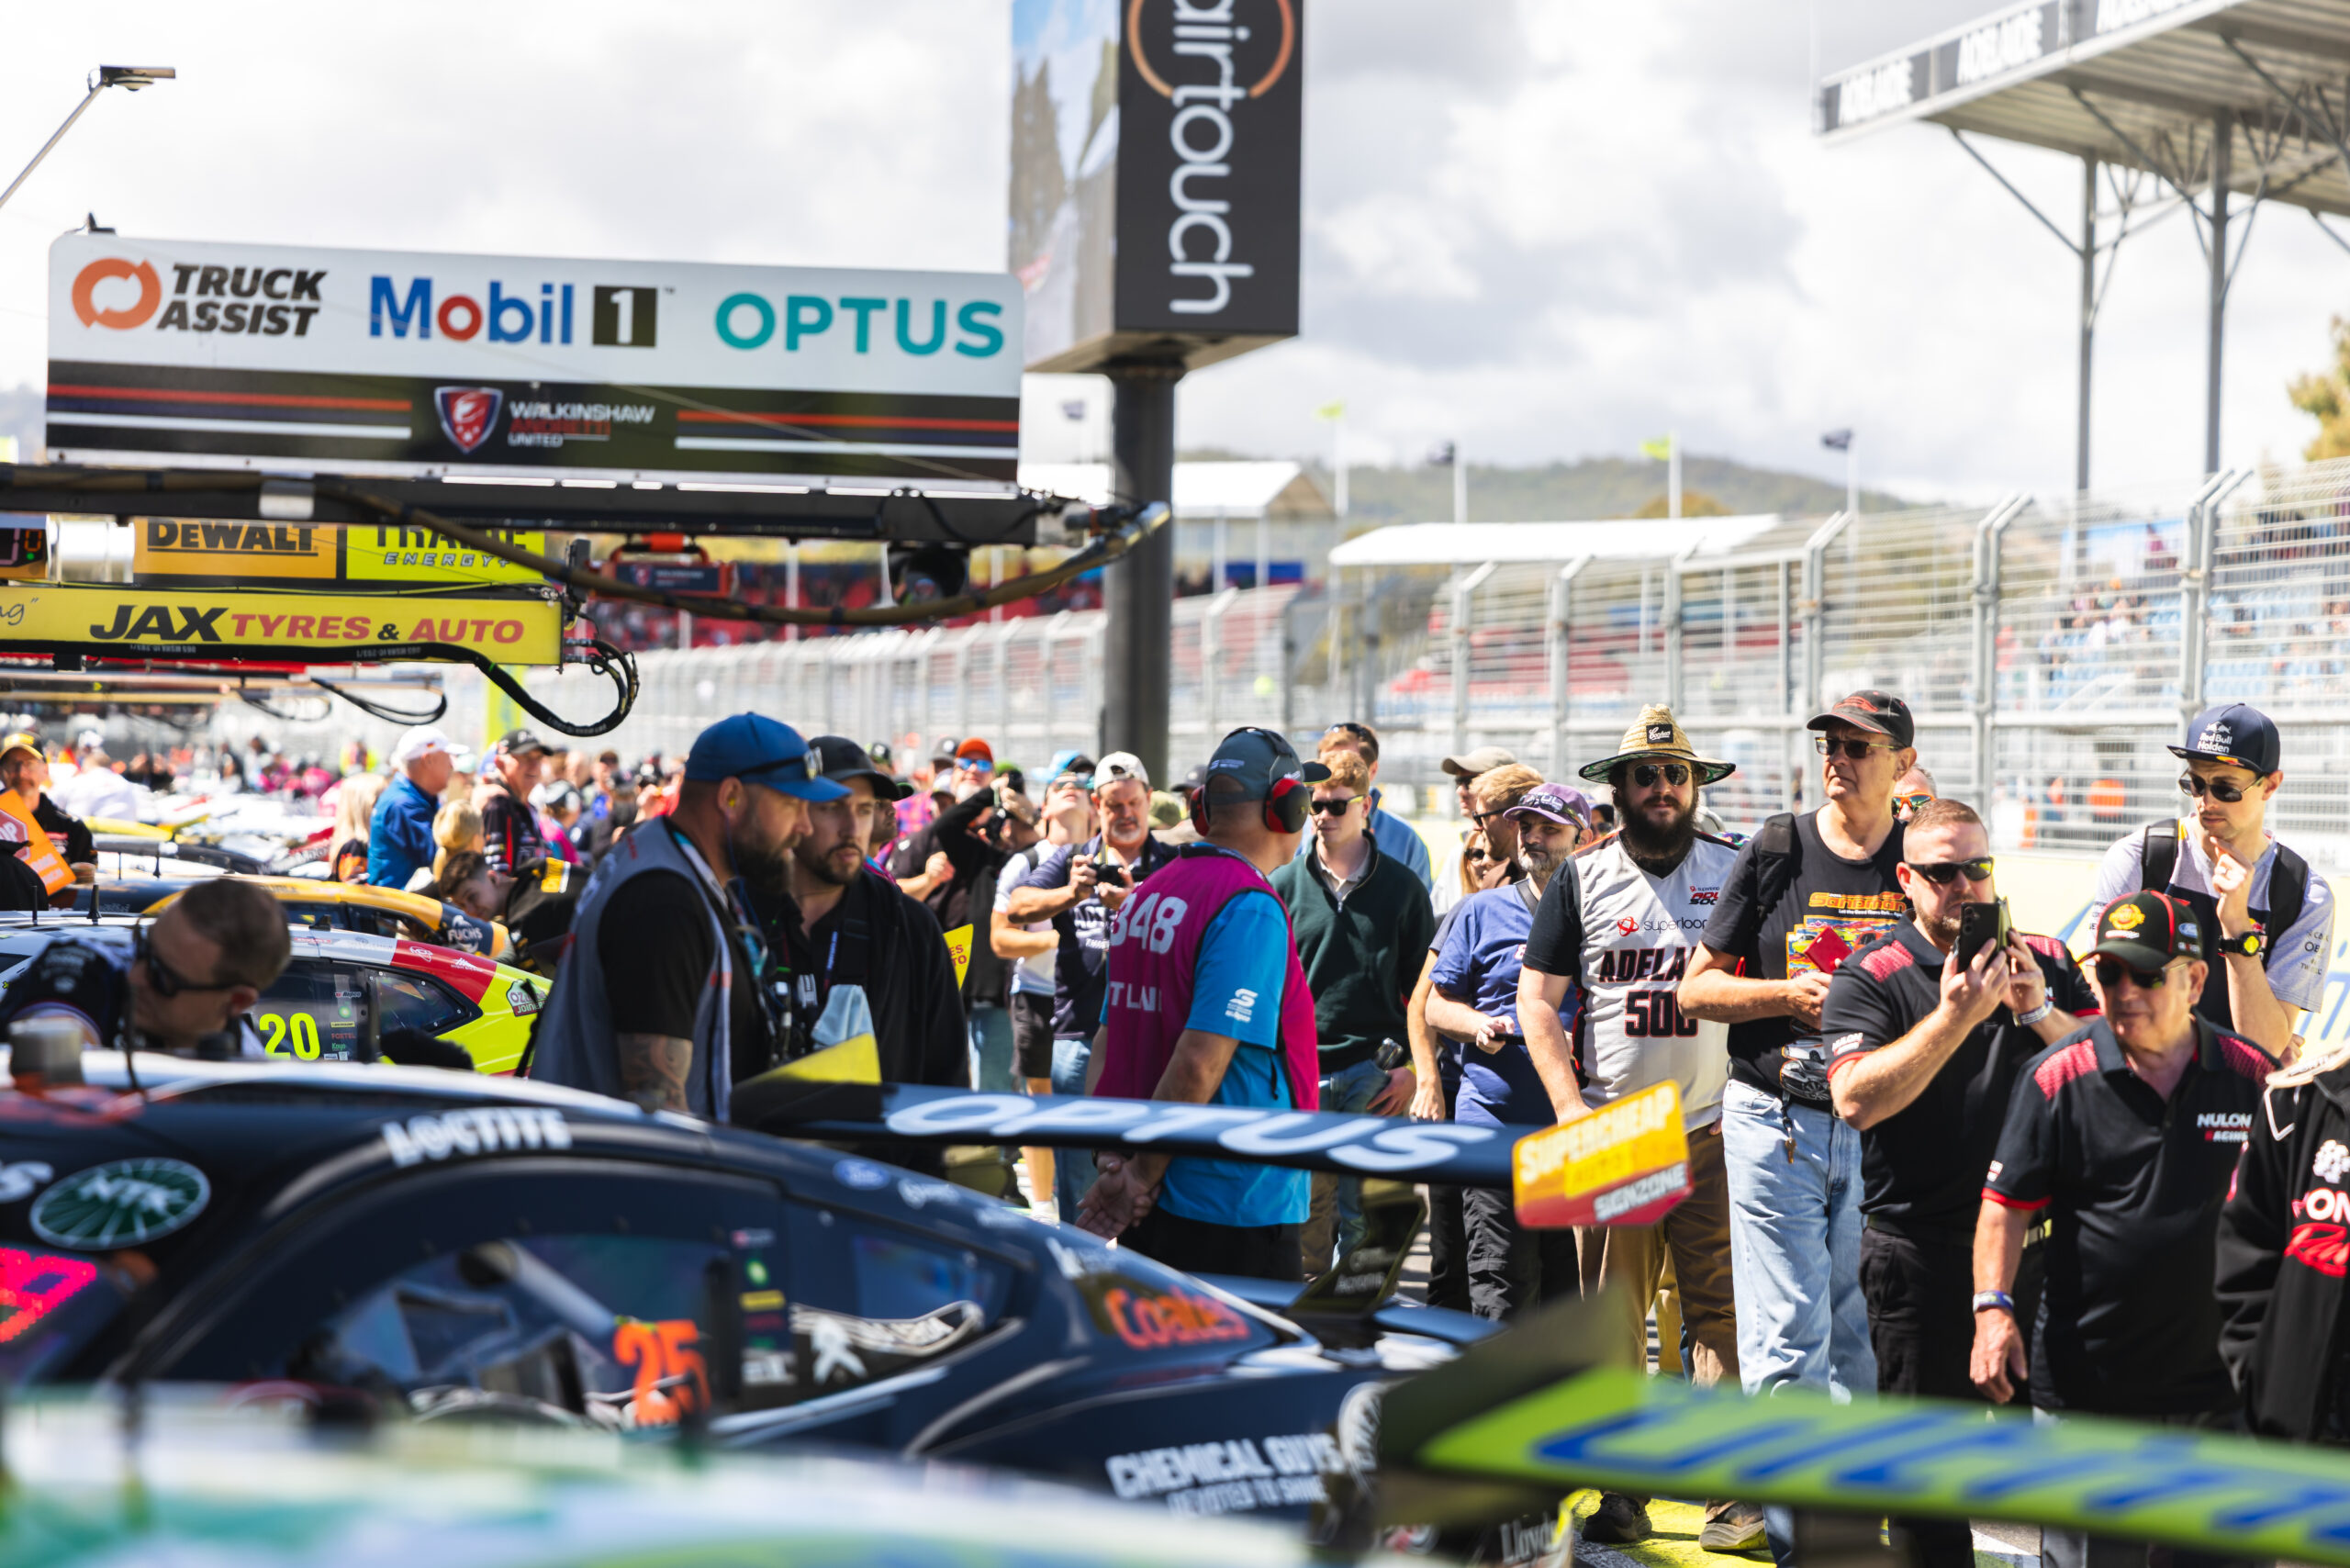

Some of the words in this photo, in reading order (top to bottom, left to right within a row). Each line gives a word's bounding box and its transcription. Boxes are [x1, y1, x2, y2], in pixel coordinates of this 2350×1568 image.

[173, 263, 328, 302] TRUCK
[157, 300, 319, 338] ASSIST
[369, 274, 575, 345] Mobil
[715, 291, 1005, 358] OPTUS
[509, 401, 656, 423] WALKINSHAW
[508, 433, 564, 448] UNITED
[89, 604, 229, 642] JAX
[230, 613, 372, 640] TYRES
[377, 623, 400, 641] &
[408, 618, 524, 644] AUTO
[2197, 740, 2230, 753] Holden
[2215, 734, 2232, 745] Bull
[448, 926, 484, 942] FUCHS
[259, 1013, 320, 1061] 20
[381, 1107, 573, 1168] LOCTITE
[887, 1094, 1497, 1171] OPTUS
[1519, 1086, 1675, 1184] SUPERCHEAP
[2196, 1113, 2253, 1128] NULON
[614, 1319, 711, 1426] 25
[1105, 1438, 1275, 1498] CHEMICAL
